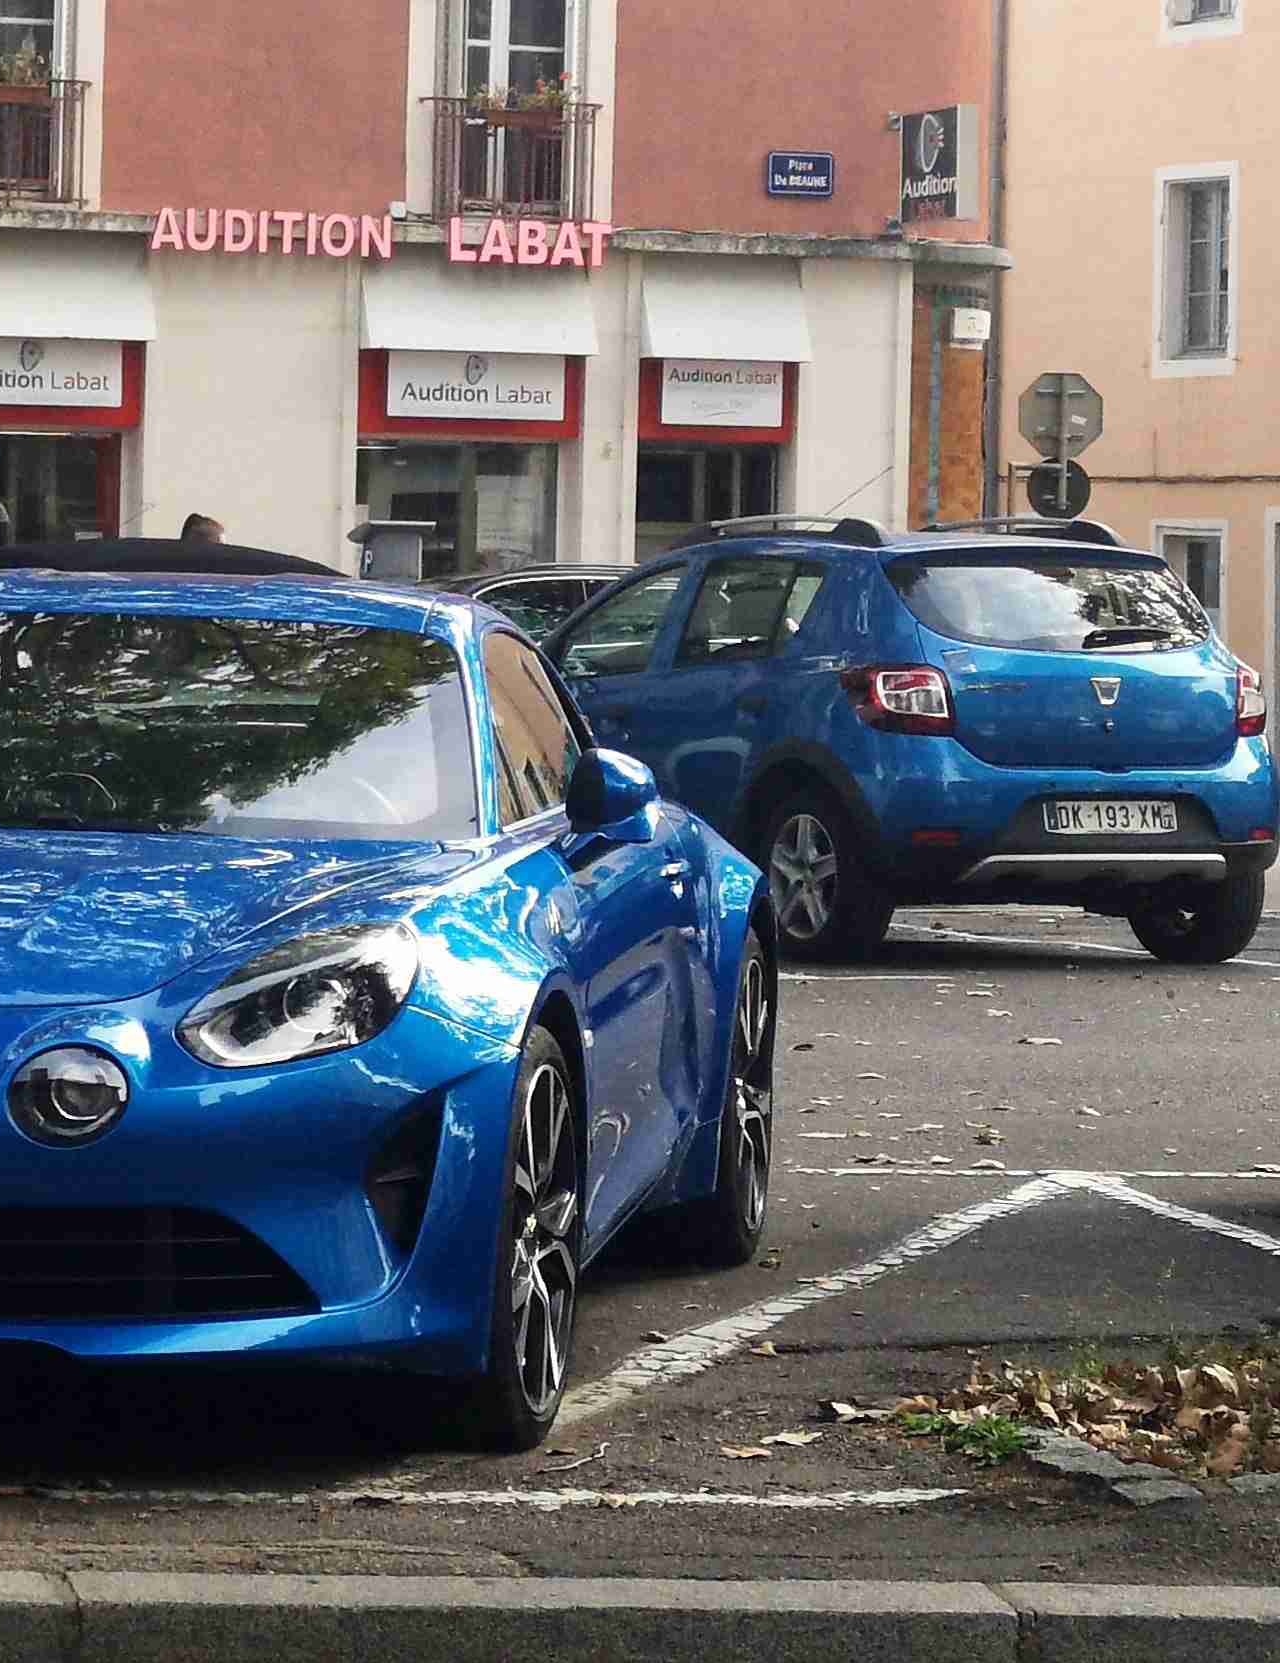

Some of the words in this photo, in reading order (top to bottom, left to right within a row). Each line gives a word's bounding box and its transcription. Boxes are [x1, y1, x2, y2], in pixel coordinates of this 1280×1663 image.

[789, 175, 828, 187] BEAUNE
[902, 173, 959, 199] Audition
[151, 206, 392, 259] AUDITION
[449, 216, 612, 267] LABAT
[51, 371, 109, 391] Labat
[401, 382, 488, 403] Audition
[495, 384, 552, 404] Labat
